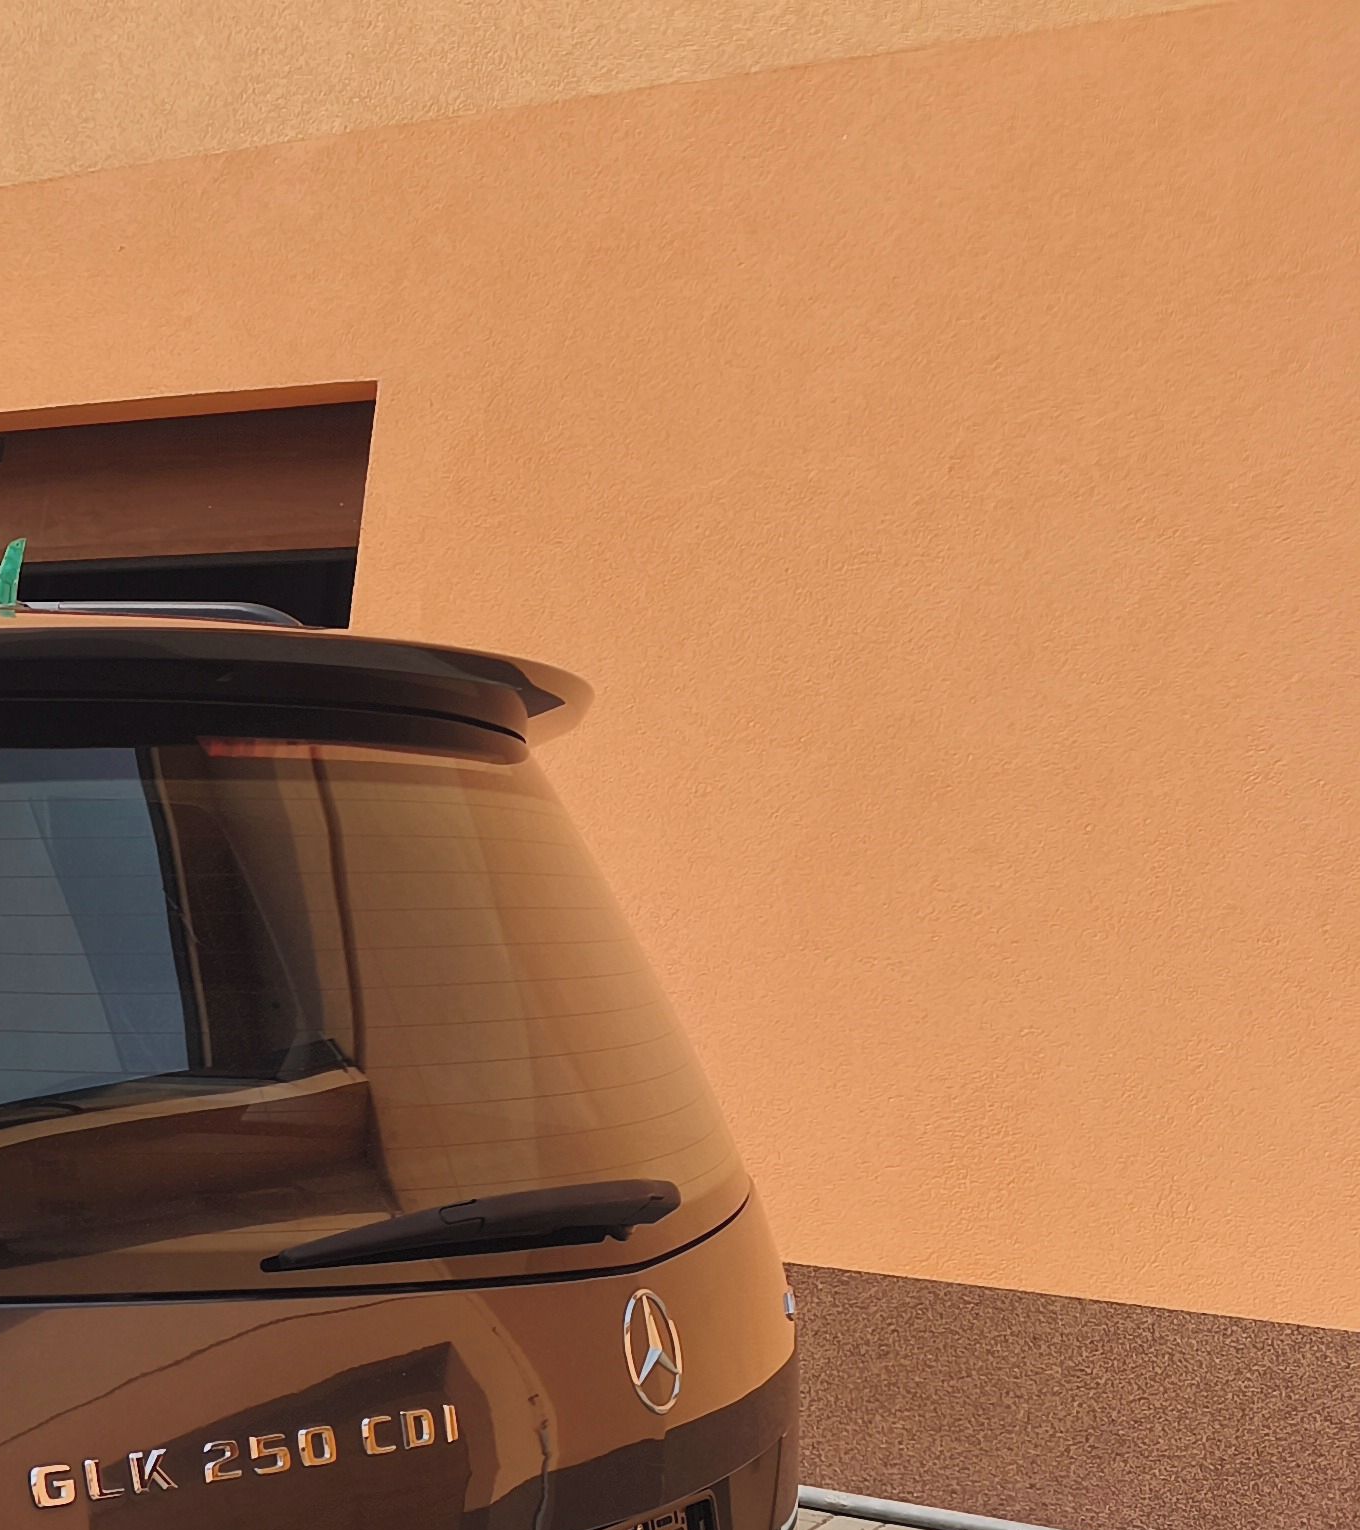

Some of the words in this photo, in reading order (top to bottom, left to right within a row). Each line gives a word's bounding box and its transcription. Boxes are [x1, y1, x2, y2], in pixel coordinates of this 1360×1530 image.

[29, 1447, 178, 1508] GLK
[203, 1424, 338, 1485] 250
[360, 1403, 460, 1456] CDI
